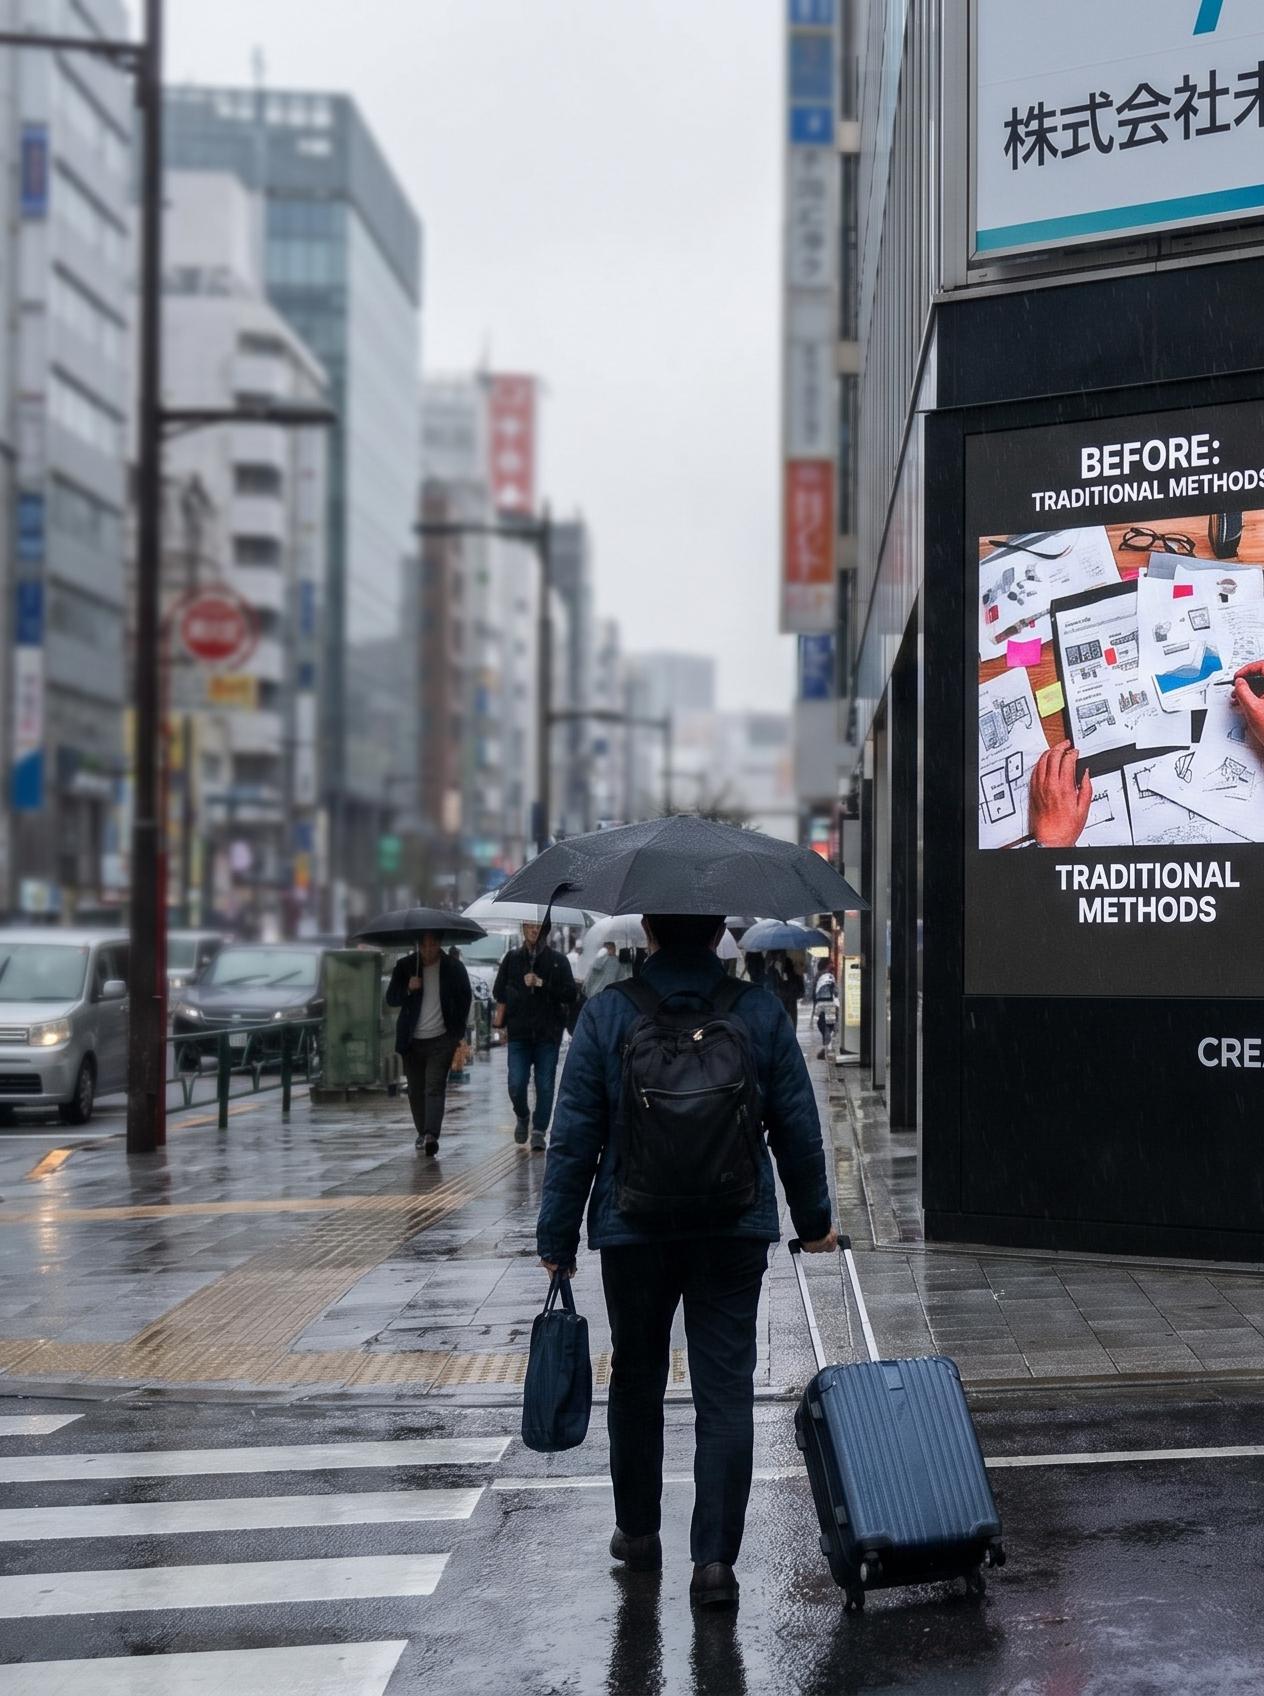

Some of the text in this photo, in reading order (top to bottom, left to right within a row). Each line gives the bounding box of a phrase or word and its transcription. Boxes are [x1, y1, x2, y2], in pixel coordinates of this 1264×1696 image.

[1081, 433, 1220, 479] BEFORE:
[1031, 479, 1165, 512] TRADITIONAL
[1055, 861, 1241, 891] TRADITIONAL
[1078, 895, 1217, 923] METHODS
